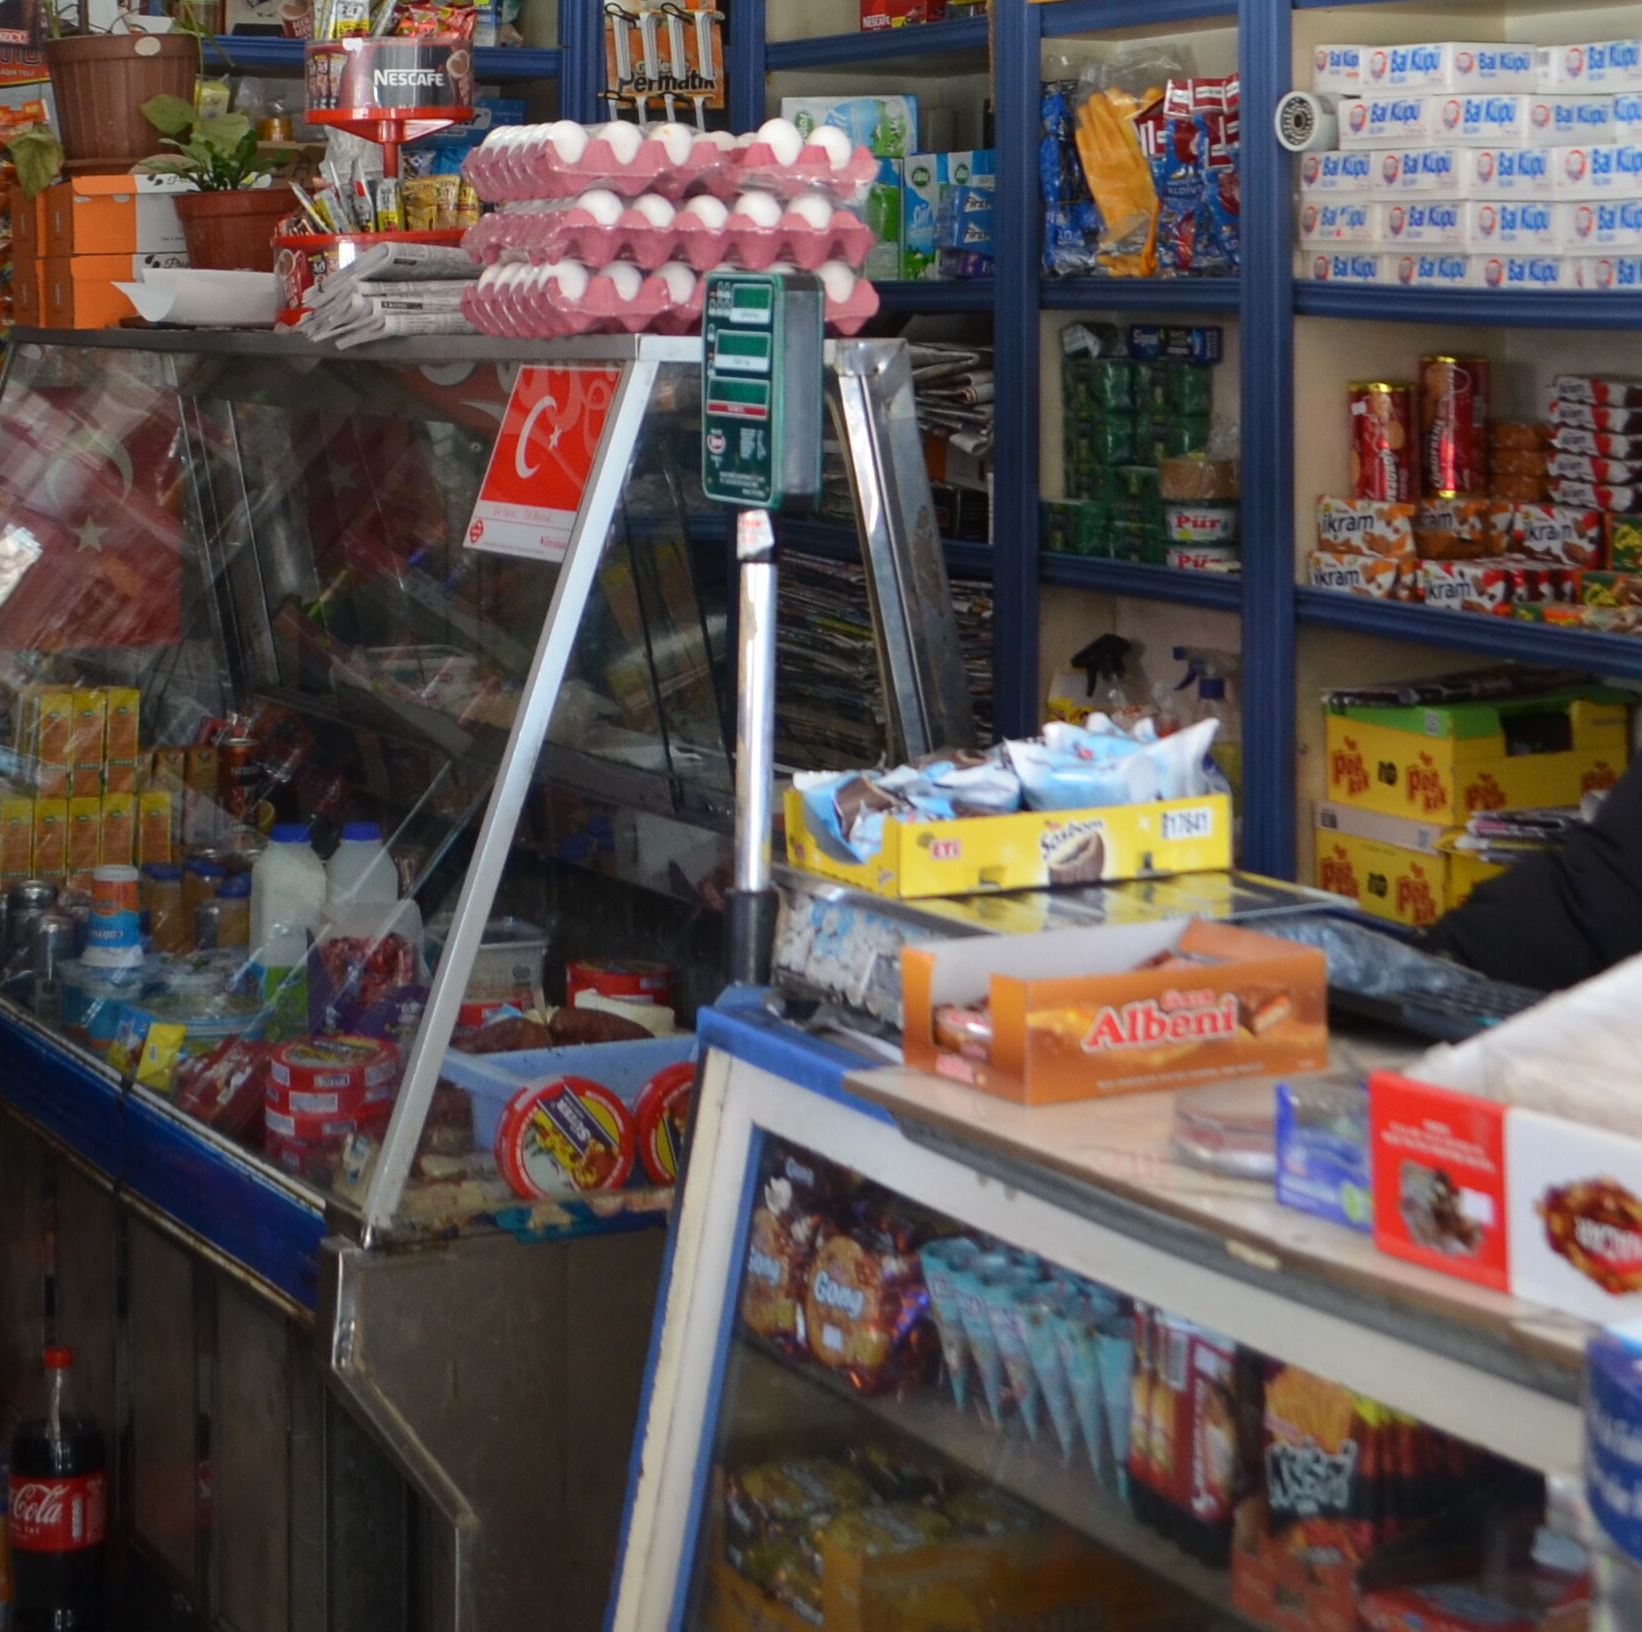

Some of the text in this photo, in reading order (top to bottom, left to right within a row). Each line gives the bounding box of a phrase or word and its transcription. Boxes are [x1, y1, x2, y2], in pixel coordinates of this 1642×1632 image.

[1322, 511, 1376, 536] ikram
[1078, 994, 1238, 1053] Albeni
[814, 1270, 865, 1316] Gong
